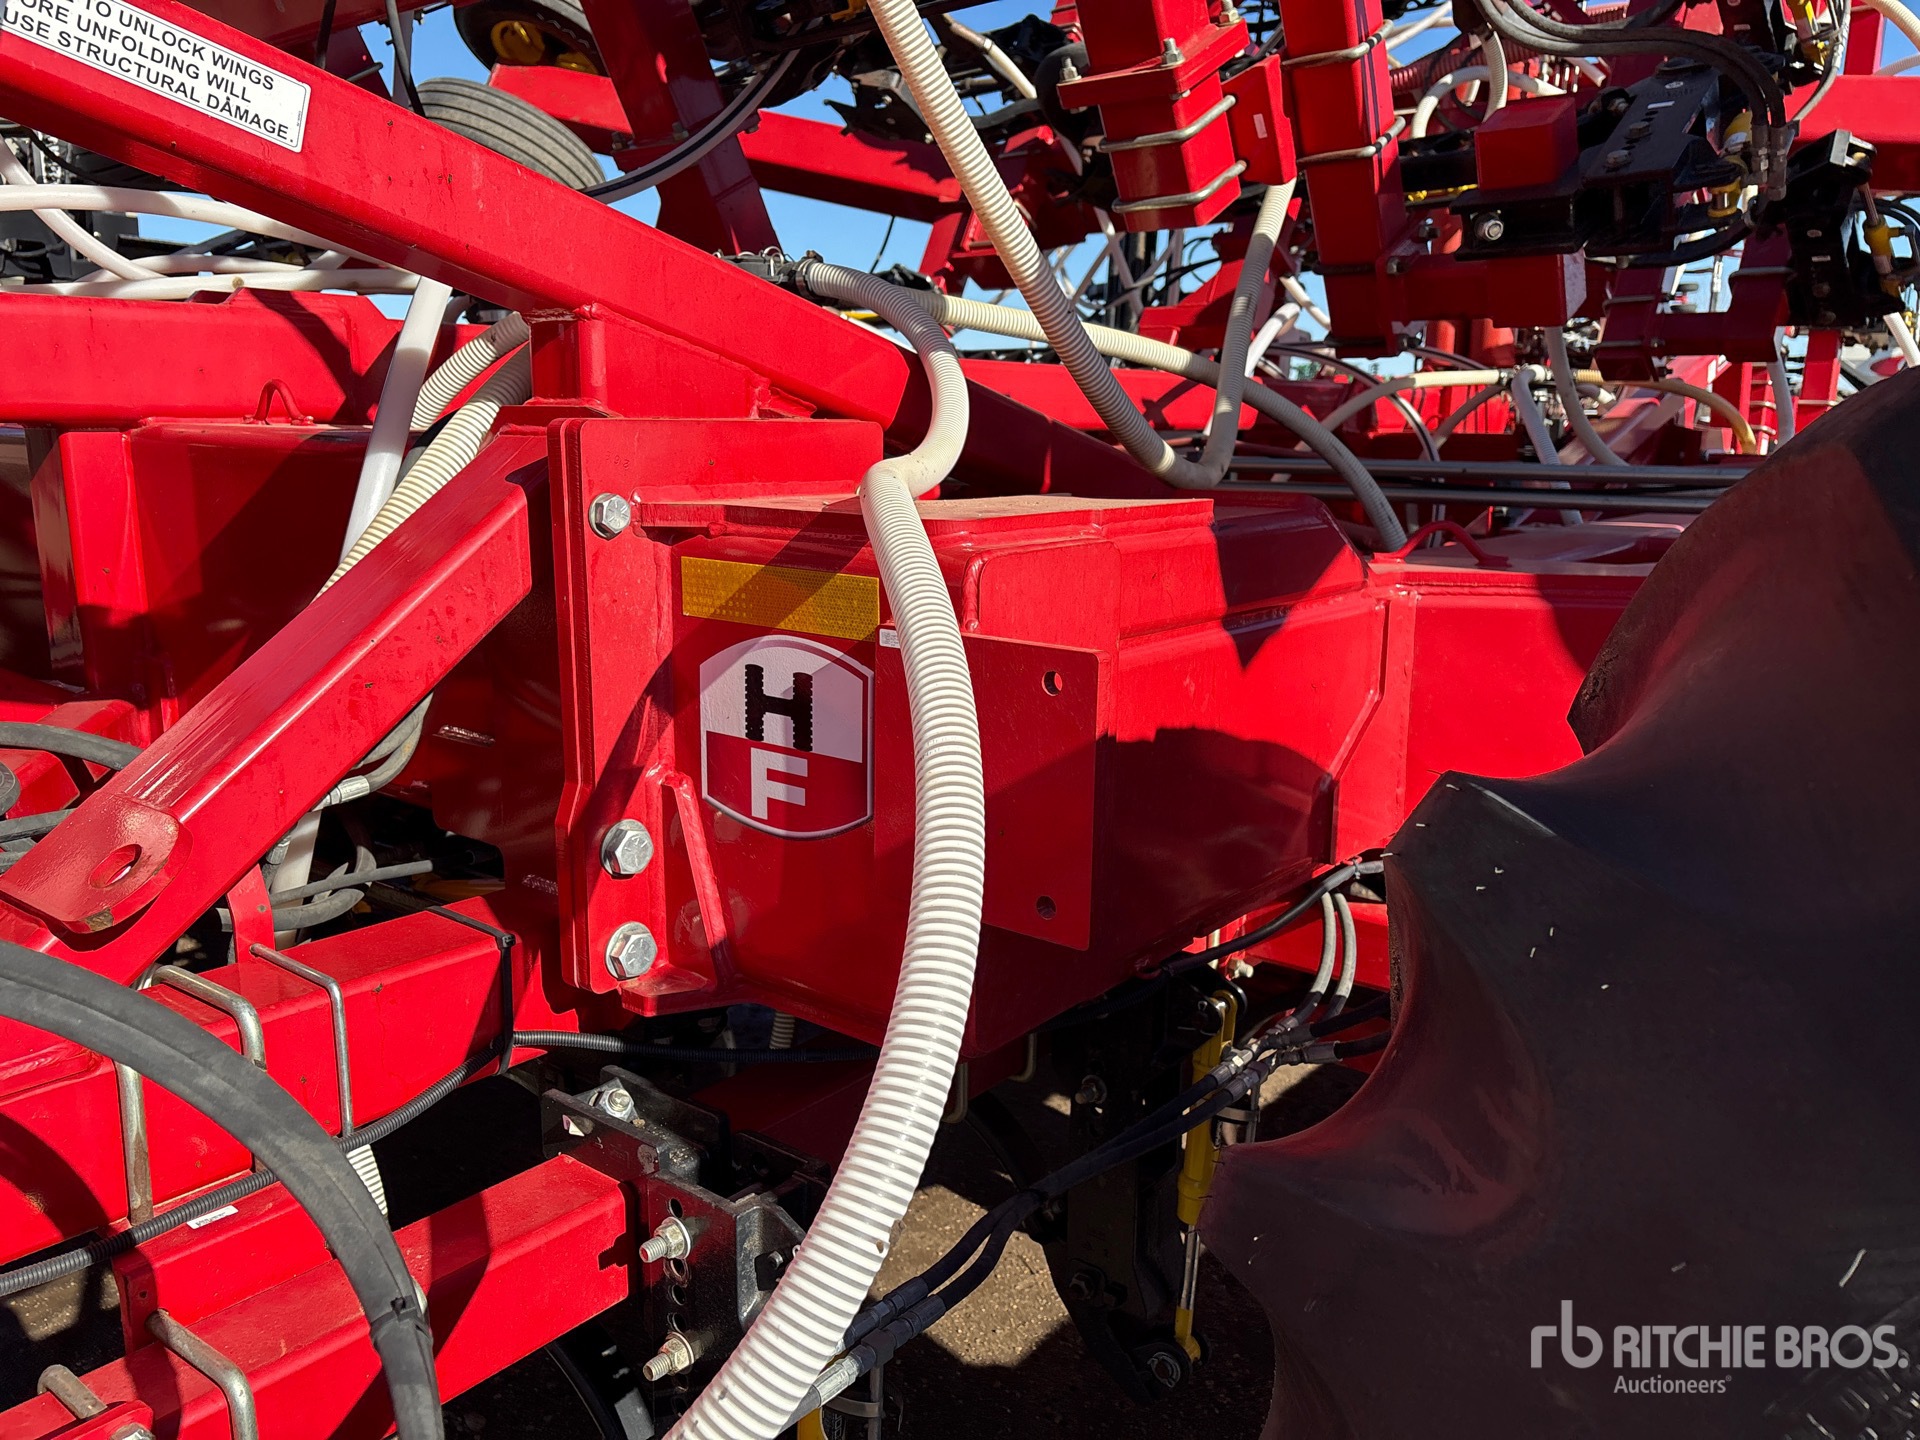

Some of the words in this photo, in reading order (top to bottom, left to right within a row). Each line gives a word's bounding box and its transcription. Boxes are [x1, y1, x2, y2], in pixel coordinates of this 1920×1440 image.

[57, 31, 200, 103] STRUCTURAL
[207, 93, 293, 142] DAMAGE.
[77, 14, 199, 79] UNFOLDING
[207, 70, 251, 103] WILL
[119, 10, 206, 61] UNLOCK
[212, 51, 274, 90] WINGS
[745, 663, 813, 753] H
[750, 746, 808, 820] F
